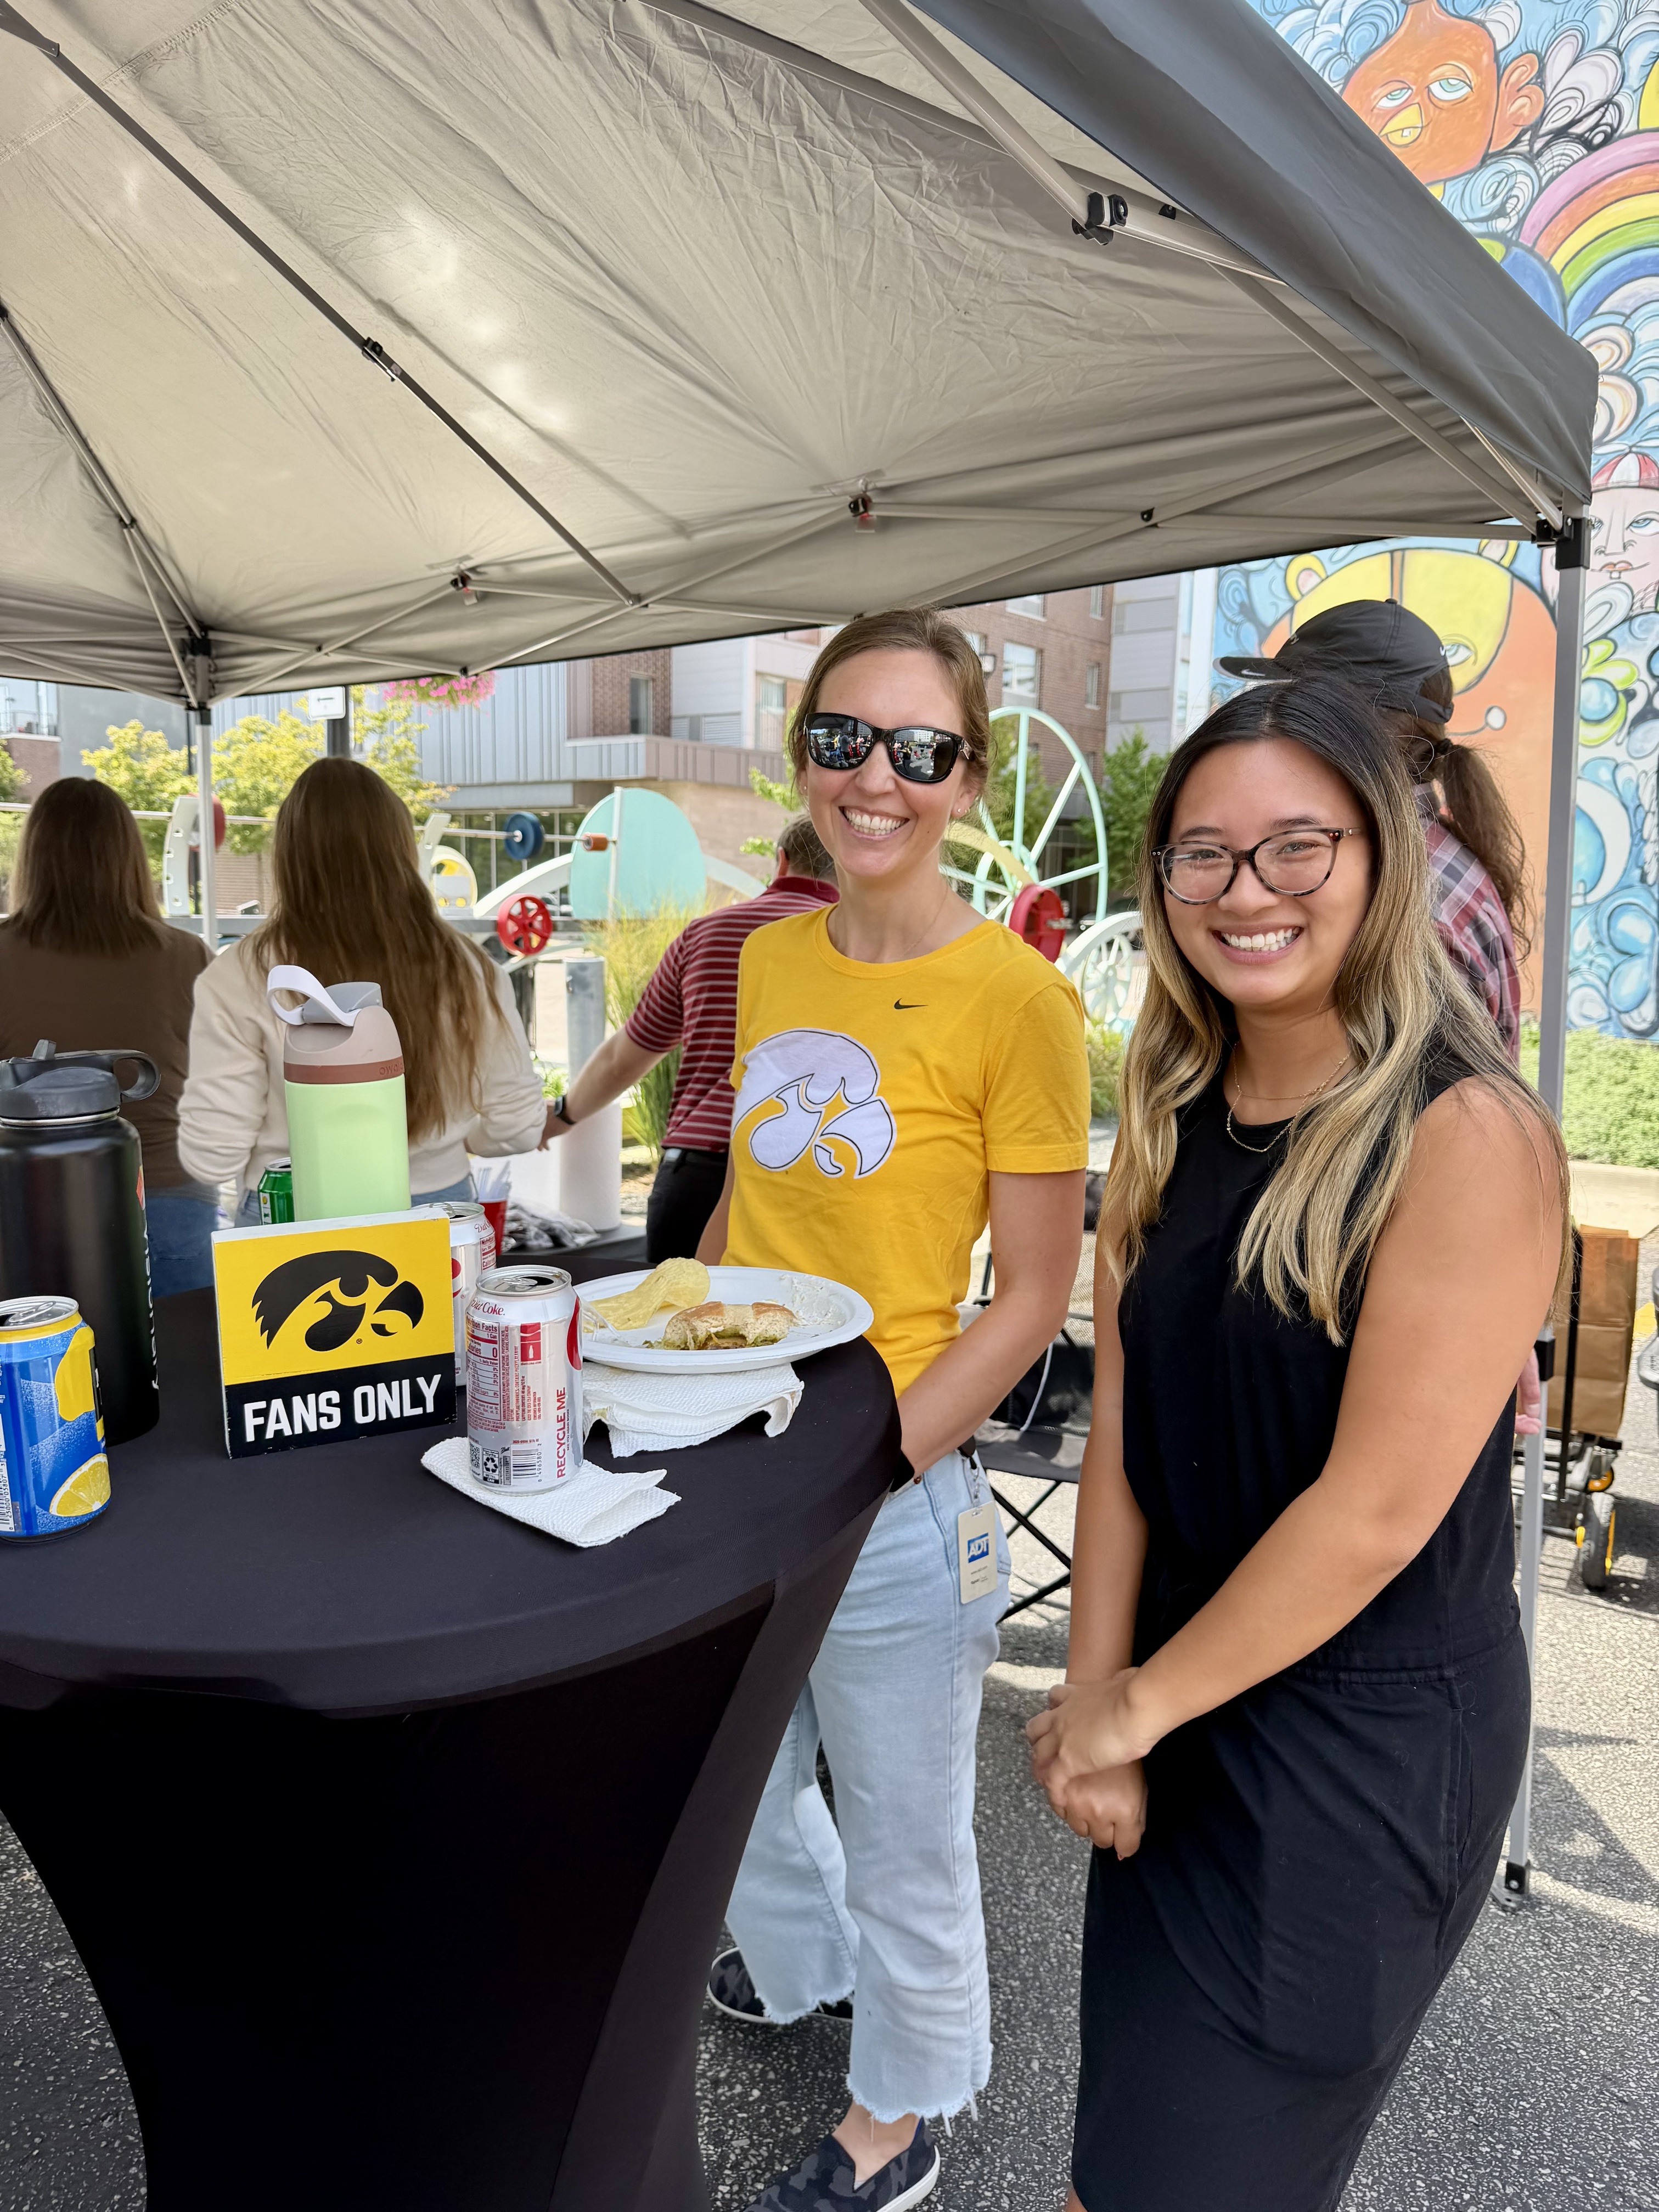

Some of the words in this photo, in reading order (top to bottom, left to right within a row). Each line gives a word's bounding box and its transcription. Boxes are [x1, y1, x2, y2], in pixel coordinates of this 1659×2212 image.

[482, 1322, 497, 1332] Facts
[492, 1347, 498, 1358] 0
[244, 1390, 341, 1443] FANS
[353, 1374, 442, 1424] ONLY
[556, 1387, 566, 1411] ME
[556, 1412, 566, 1478] RECYCLE
[968, 1537, 988, 1557] ADT
